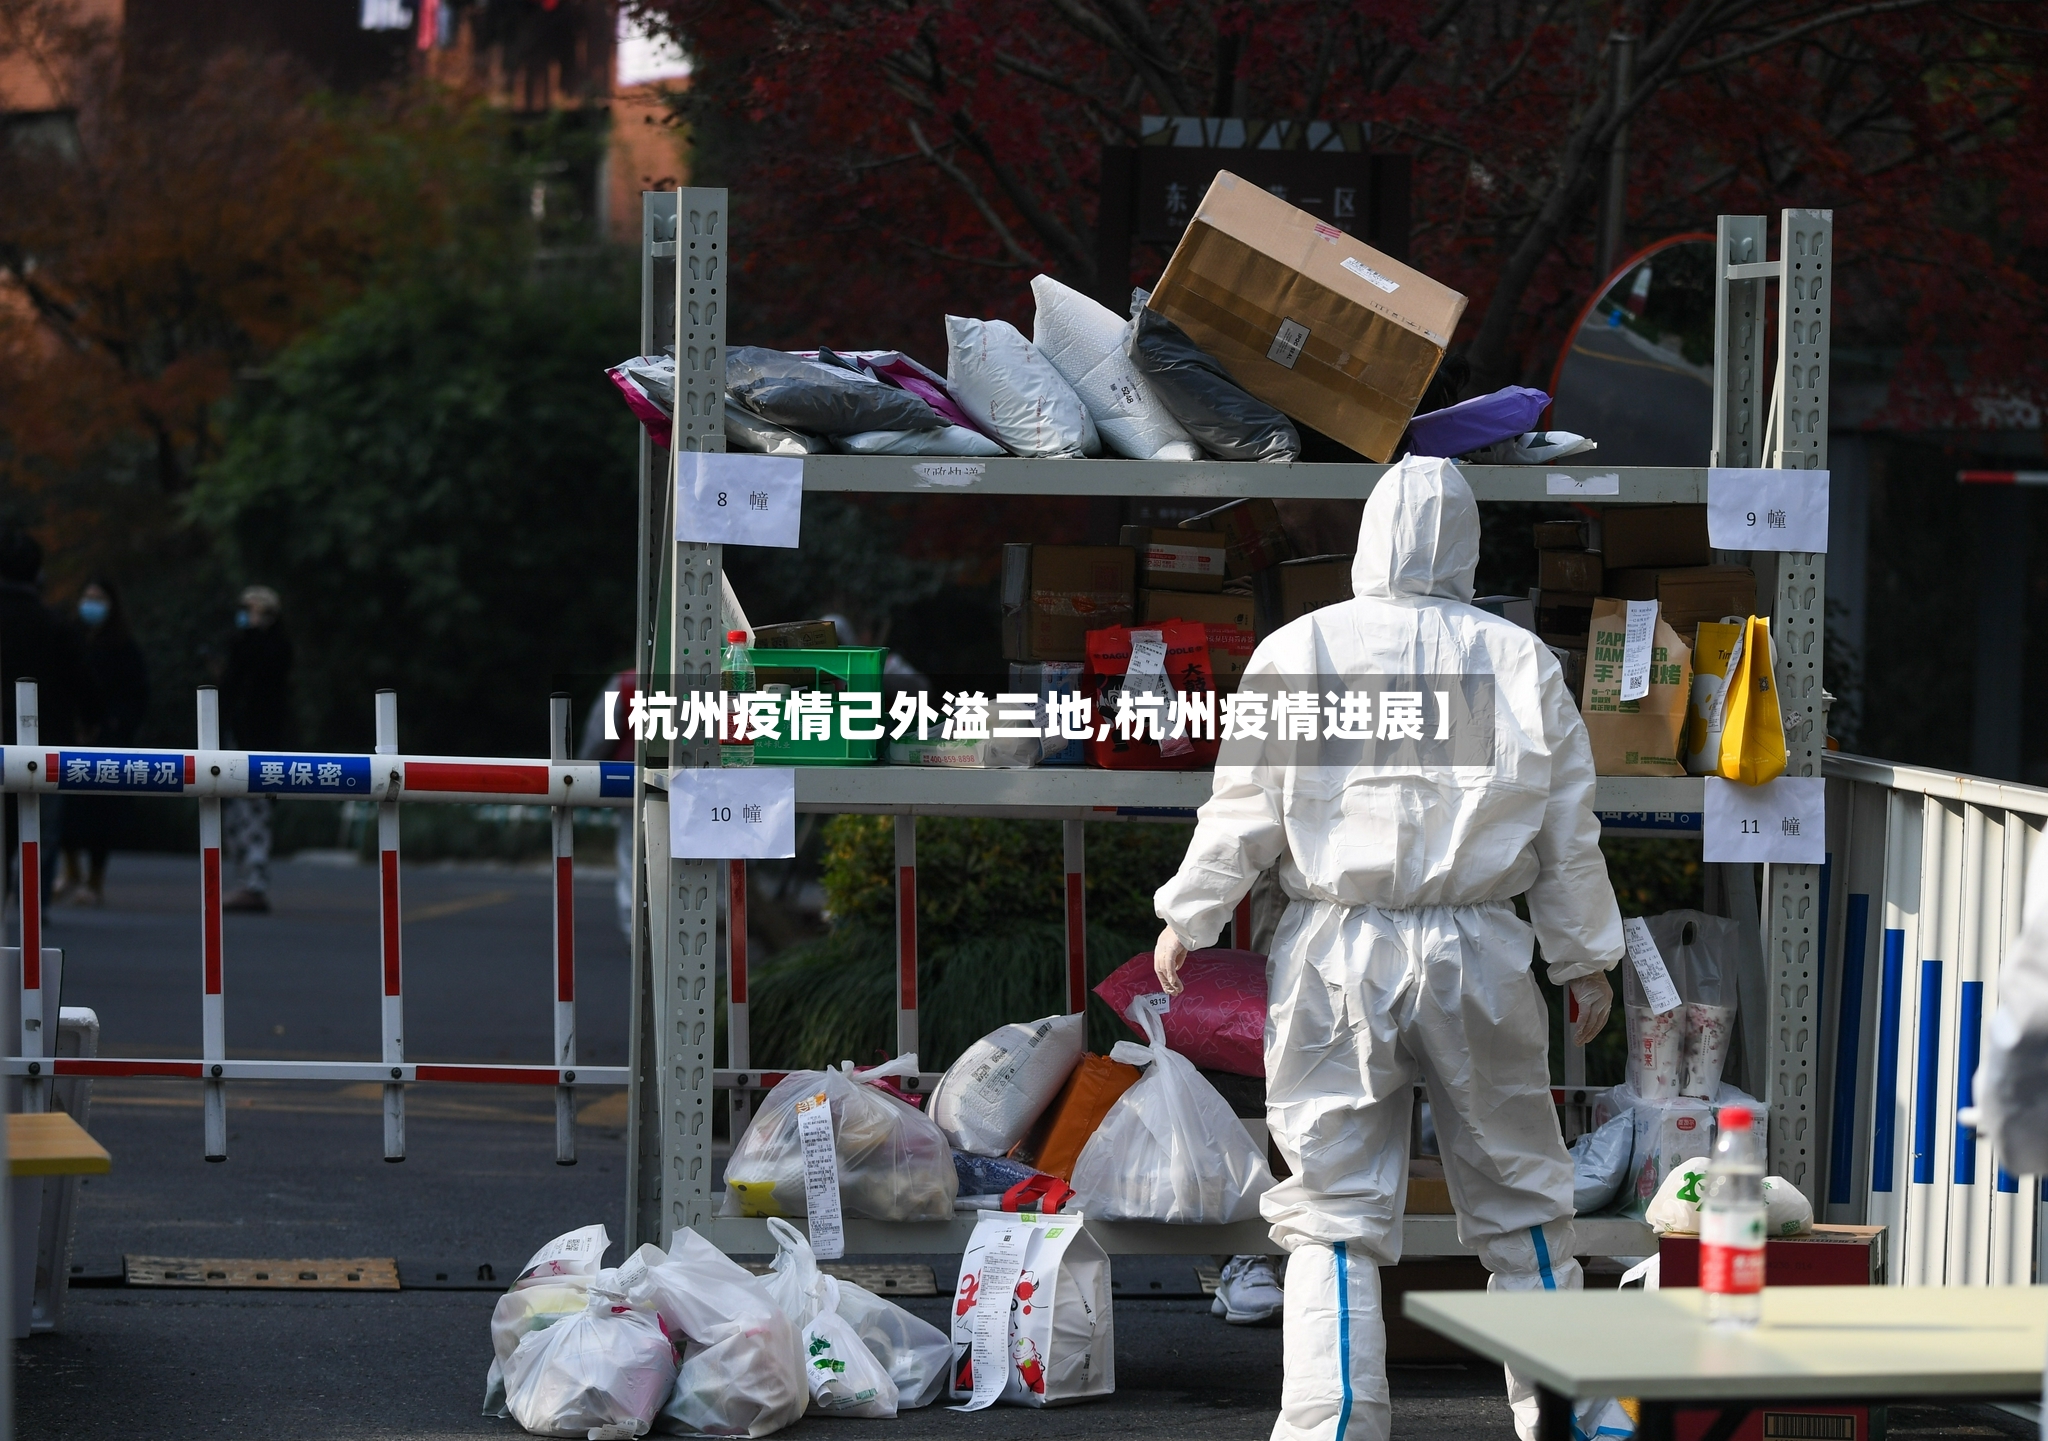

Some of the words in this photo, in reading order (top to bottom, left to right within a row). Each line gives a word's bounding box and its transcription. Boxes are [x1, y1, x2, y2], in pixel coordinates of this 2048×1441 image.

[718, 492, 728, 507] 8
[749, 490, 769, 511] 幢
[1746, 511, 1757, 527] 9
[1767, 509, 1787, 529] 幢
[1597, 631, 1626, 646] HAP
[1595, 647, 1668, 662] HAMER
[66, 758, 178, 785] 家庭情况
[259, 761, 357, 787] 要保密。
[711, 806, 732, 822] 10
[742, 803, 762, 824] 幢
[1741, 819, 1760, 834] 11
[1781, 816, 1801, 837] 幢
